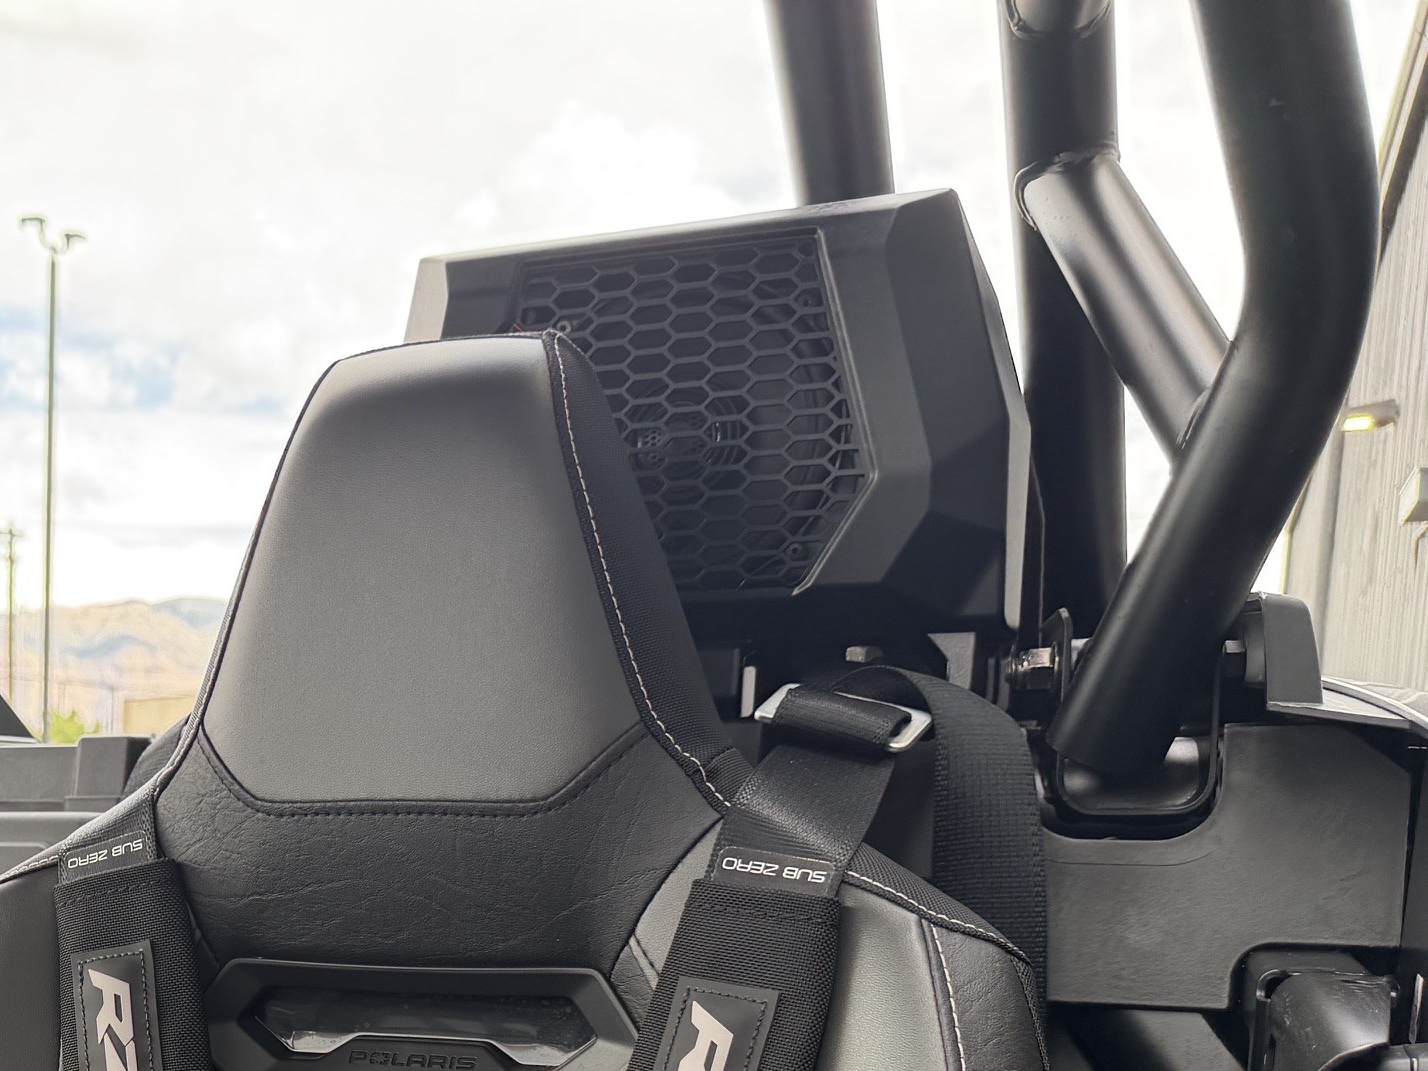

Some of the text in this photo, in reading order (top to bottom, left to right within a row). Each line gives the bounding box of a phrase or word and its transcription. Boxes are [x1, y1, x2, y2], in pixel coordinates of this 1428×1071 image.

[67, 839, 143, 869] SUB ZERO
[722, 857, 828, 883] SUB ZERO
[348, 1050, 477, 1070] POLARIS
